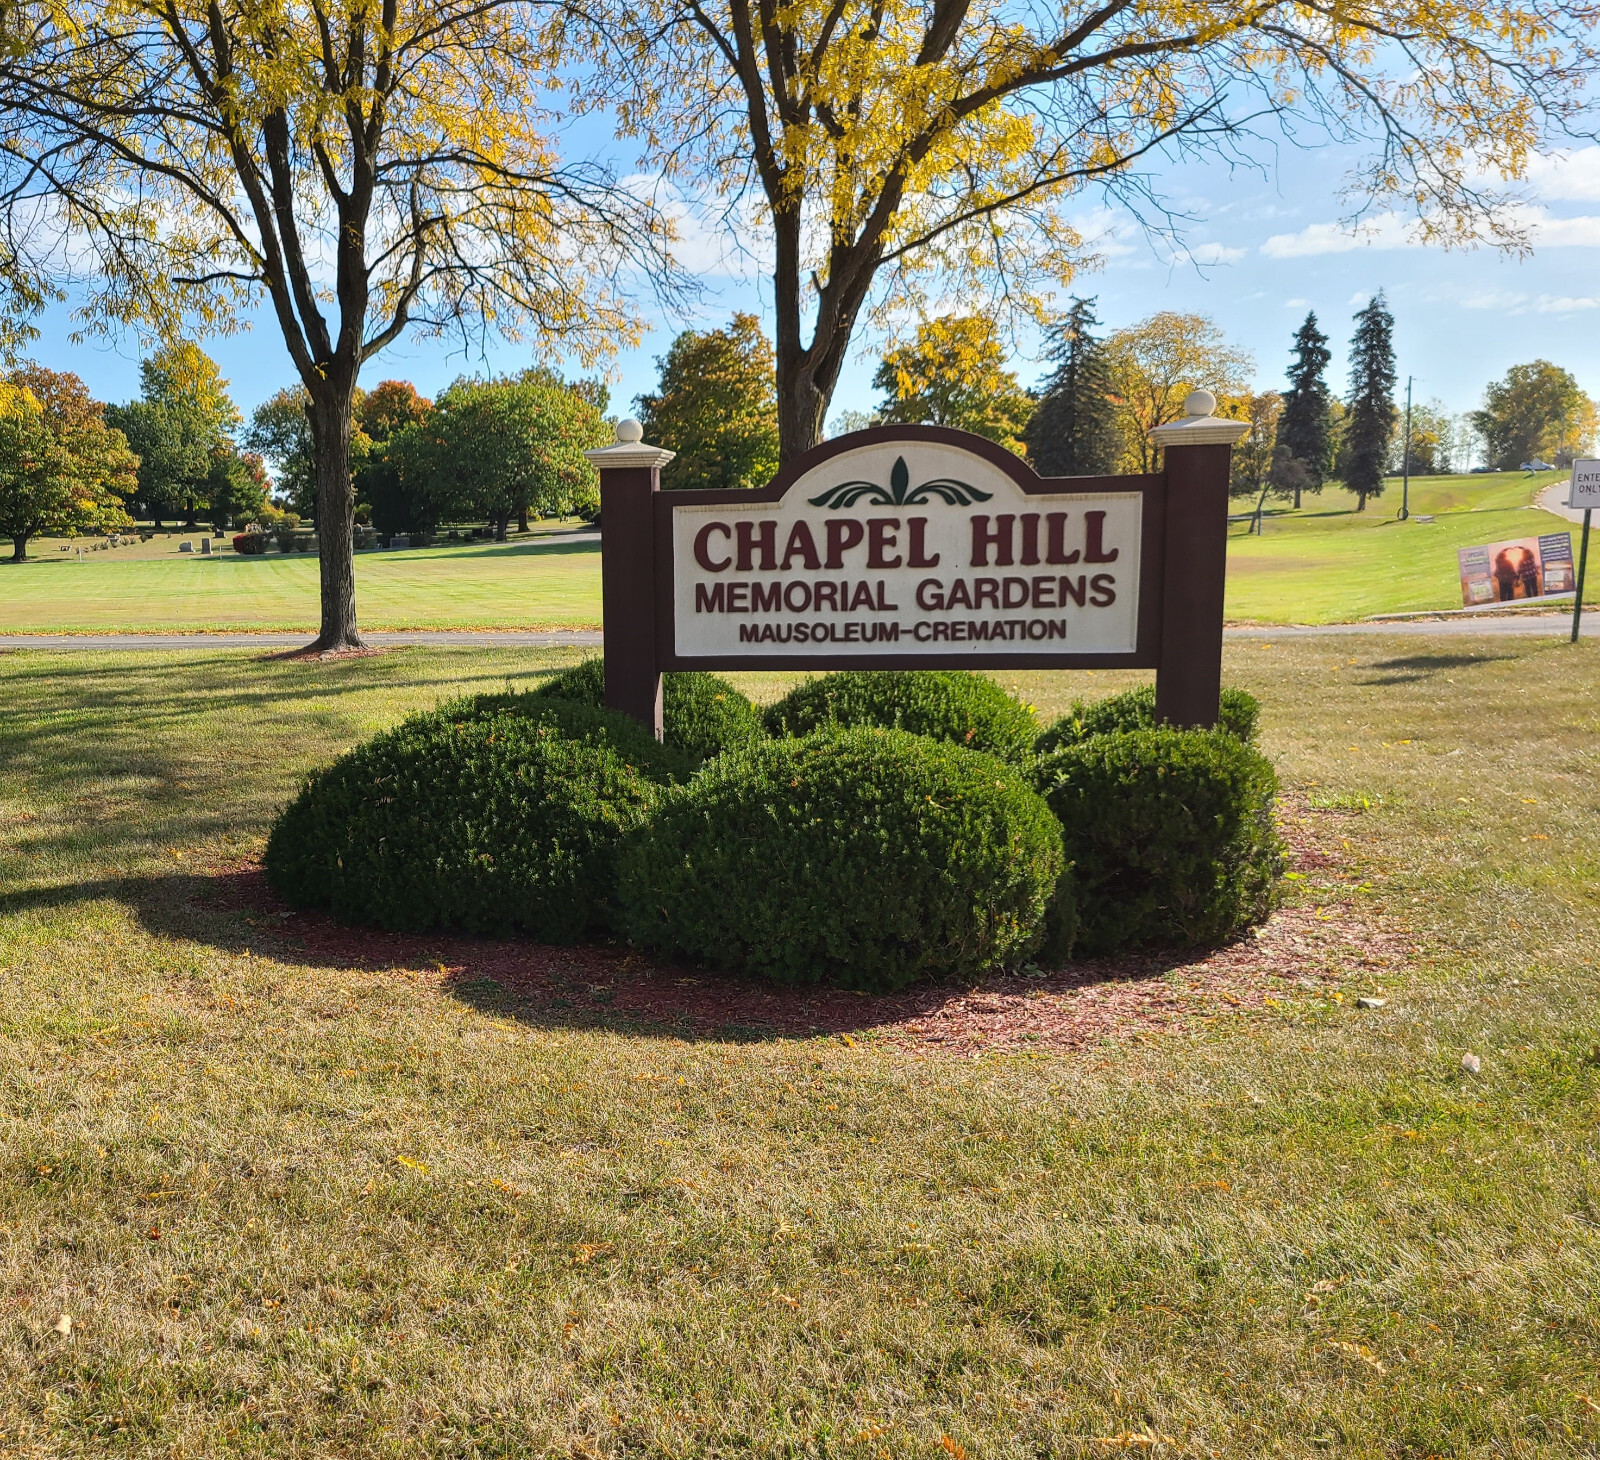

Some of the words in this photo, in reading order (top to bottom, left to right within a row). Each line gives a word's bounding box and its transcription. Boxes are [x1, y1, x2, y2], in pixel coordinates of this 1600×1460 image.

[693, 517, 941, 572] CHAPEL
[970, 510, 1119, 567] HILL
[695, 580, 898, 613] MEMORIAL
[915, 573, 1117, 611] GARDENS
